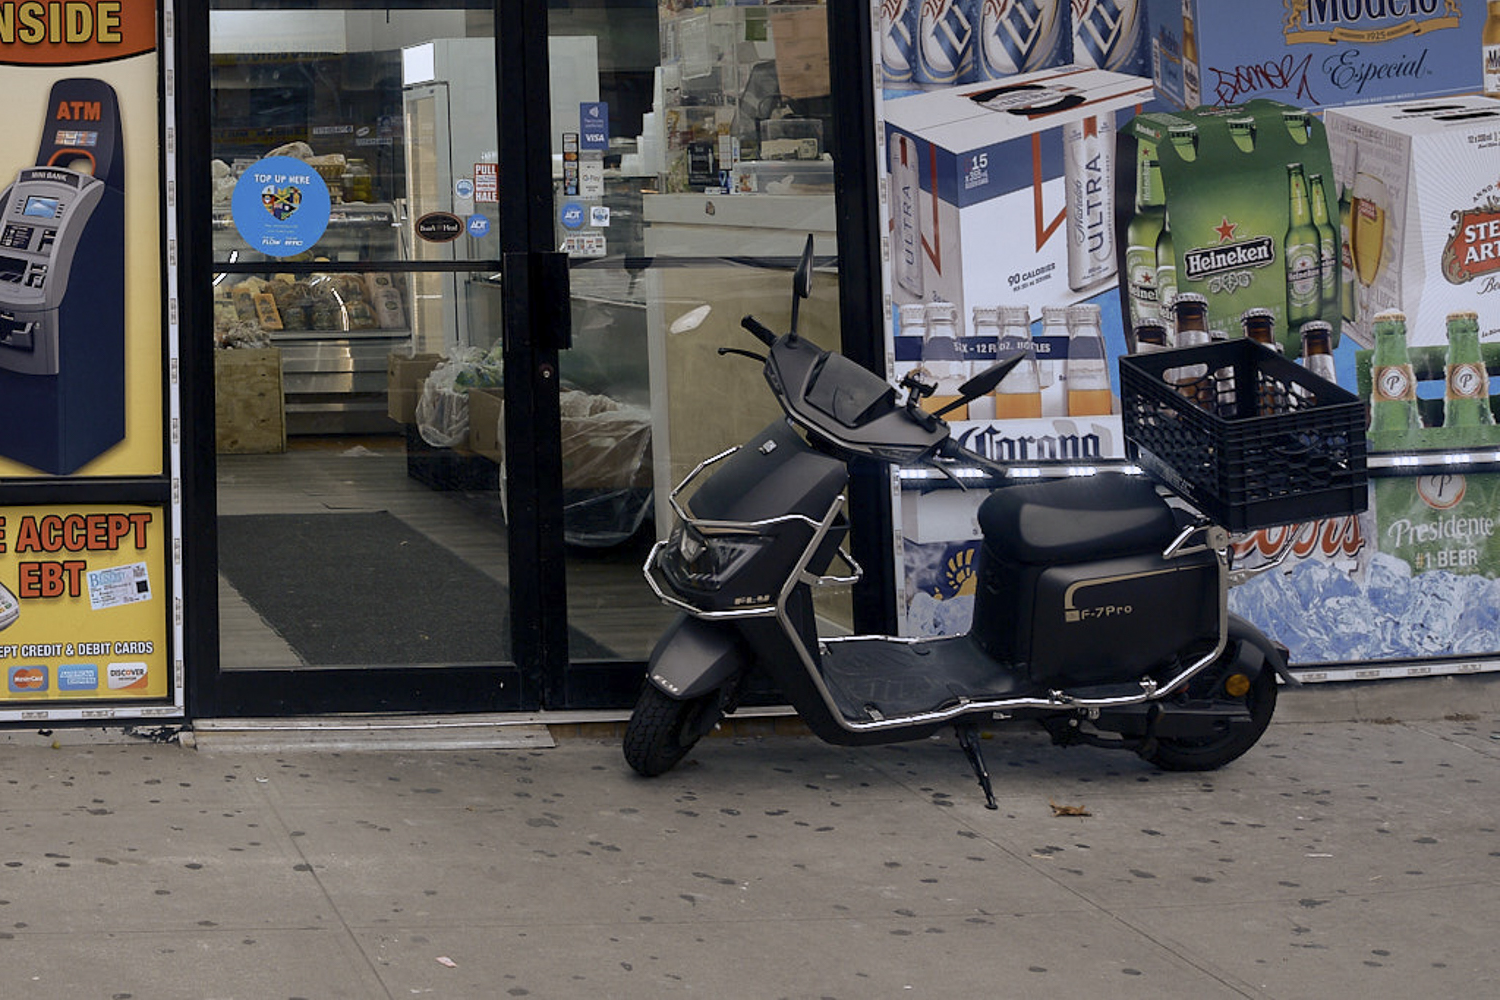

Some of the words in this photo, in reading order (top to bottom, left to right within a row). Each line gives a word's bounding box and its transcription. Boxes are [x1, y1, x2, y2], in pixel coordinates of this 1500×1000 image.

[1322, 49, 1428, 94] Especial
[56, 101, 101, 121] ATM
[585, 133, 605, 142] VISA
[476, 164, 497, 175] PULL
[972, 153, 988, 170] 15
[254, 174, 272, 183] TOP
[274, 174, 287, 183] UP
[288, 175, 310, 184] HERE
[476, 192, 497, 202] HALE
[1086, 152, 1104, 255] ULTRA
[903, 185, 915, 265] ULTRA
[1187, 240, 1270, 273] Heineken
[1007, 272, 1020, 286] 90
[1022, 262, 1056, 282] CALORIES
[976, 344, 987, 354] 12
[15, 512, 152, 553] ACCEPT
[1388, 514, 1494, 549] Presidente
[1438, 549, 1479, 567] BEER
[18, 560, 87, 598] EBT
[21, 643, 62, 657] CREDIT
[66, 644, 74, 656] &
[78, 642, 112, 656] DEBIT
[115, 641, 154, 654] CARDS
[110, 668, 145, 677] DISCOVER
